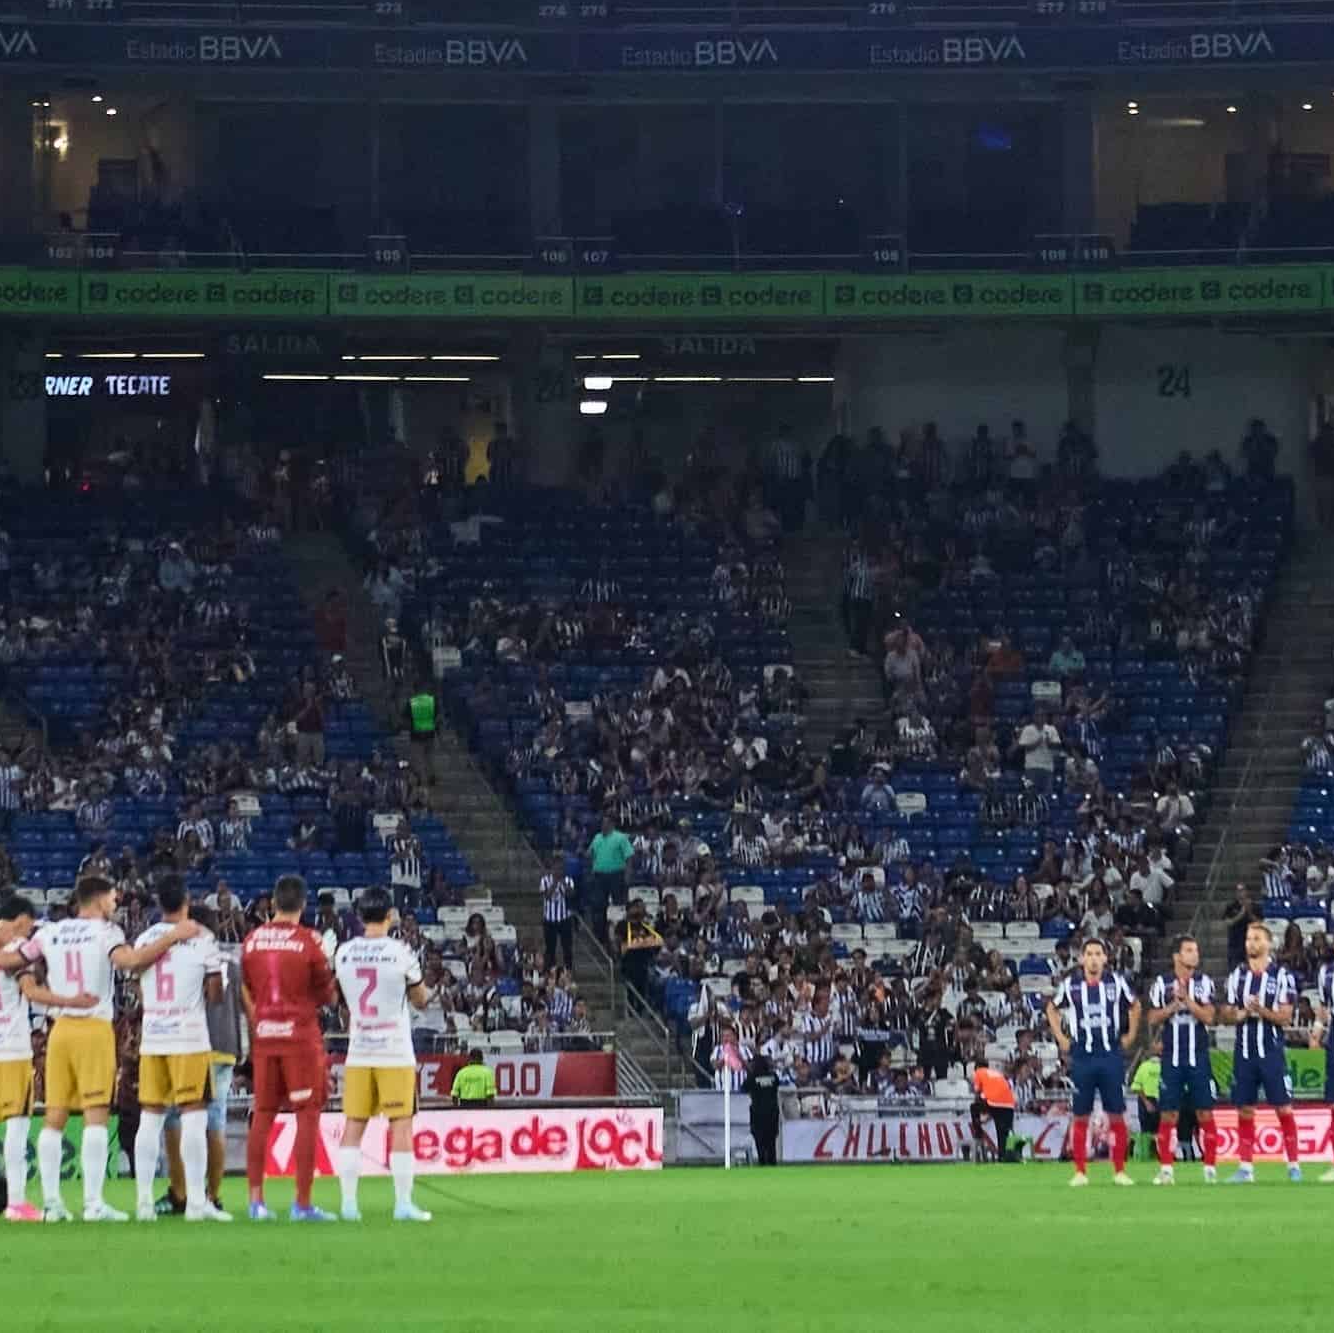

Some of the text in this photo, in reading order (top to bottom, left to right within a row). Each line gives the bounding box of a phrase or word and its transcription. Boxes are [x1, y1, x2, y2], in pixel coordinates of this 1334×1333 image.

[200, 35, 283, 61] BBVA
[445, 38, 528, 65] BBVA
[694, 38, 779, 66] BBVA
[942, 36, 1026, 63] BBVA
[1190, 29, 1274, 58] BBVA
[114, 283, 198, 305] codere
[232, 283, 316, 305] codere
[367, 283, 446, 306] codere
[481, 284, 563, 307] codere
[610, 284, 695, 307] codere
[728, 284, 812, 307] codere
[861, 284, 945, 307] codere
[978, 283, 1062, 305] codere
[1108, 281, 1194, 303] codere
[1227, 277, 1313, 299] codere
[105, 375, 171, 395] TECATE
[1157, 364, 1191, 398] 24
[64, 950, 85, 996] 4
[155, 952, 176, 1002] 6
[356, 968, 379, 1018] 2
[494, 1061, 541, 1097] 0.0
